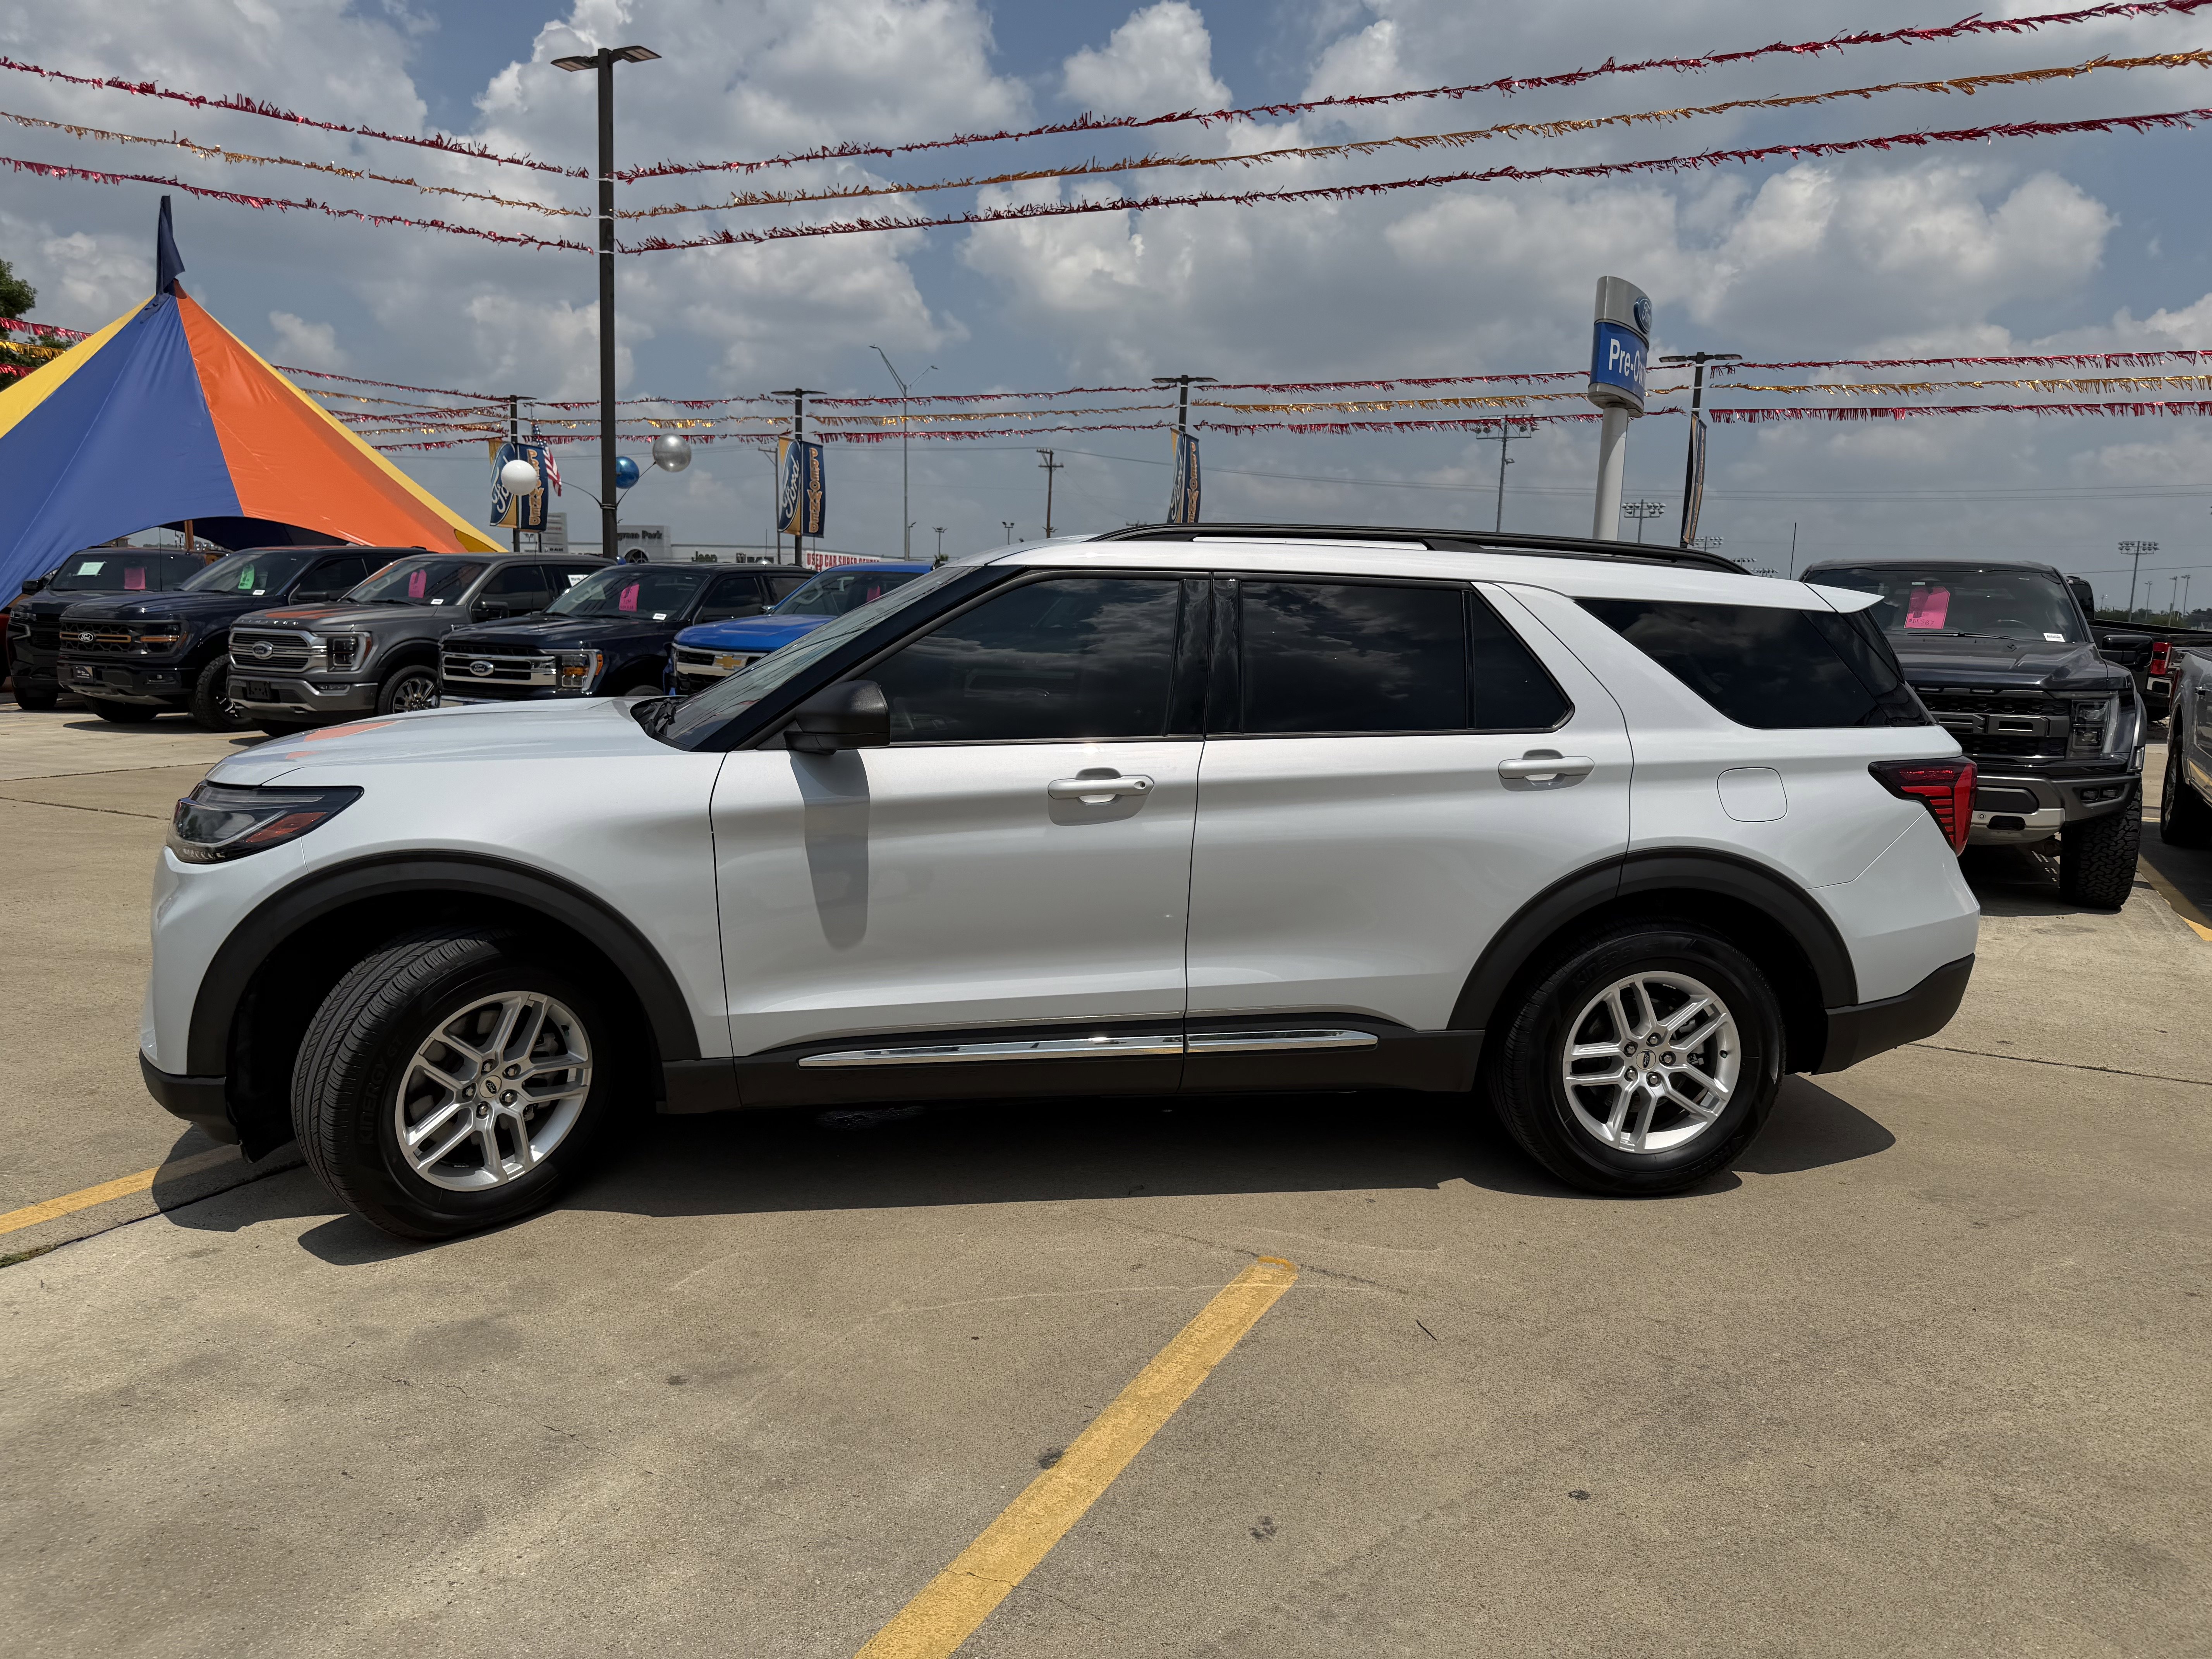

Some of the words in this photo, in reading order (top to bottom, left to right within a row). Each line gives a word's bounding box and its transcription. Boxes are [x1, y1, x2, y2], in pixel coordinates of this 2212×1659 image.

[782, 454, 800, 519] Ford
[1187, 441, 1199, 523] PREOWNE
[642, 530, 662, 539] Park
[807, 553, 823, 566] USED
[824, 554, 837, 567] CAR
[1930, 711, 2051, 737] RD
[1573, 945, 1637, 987] KINERG
